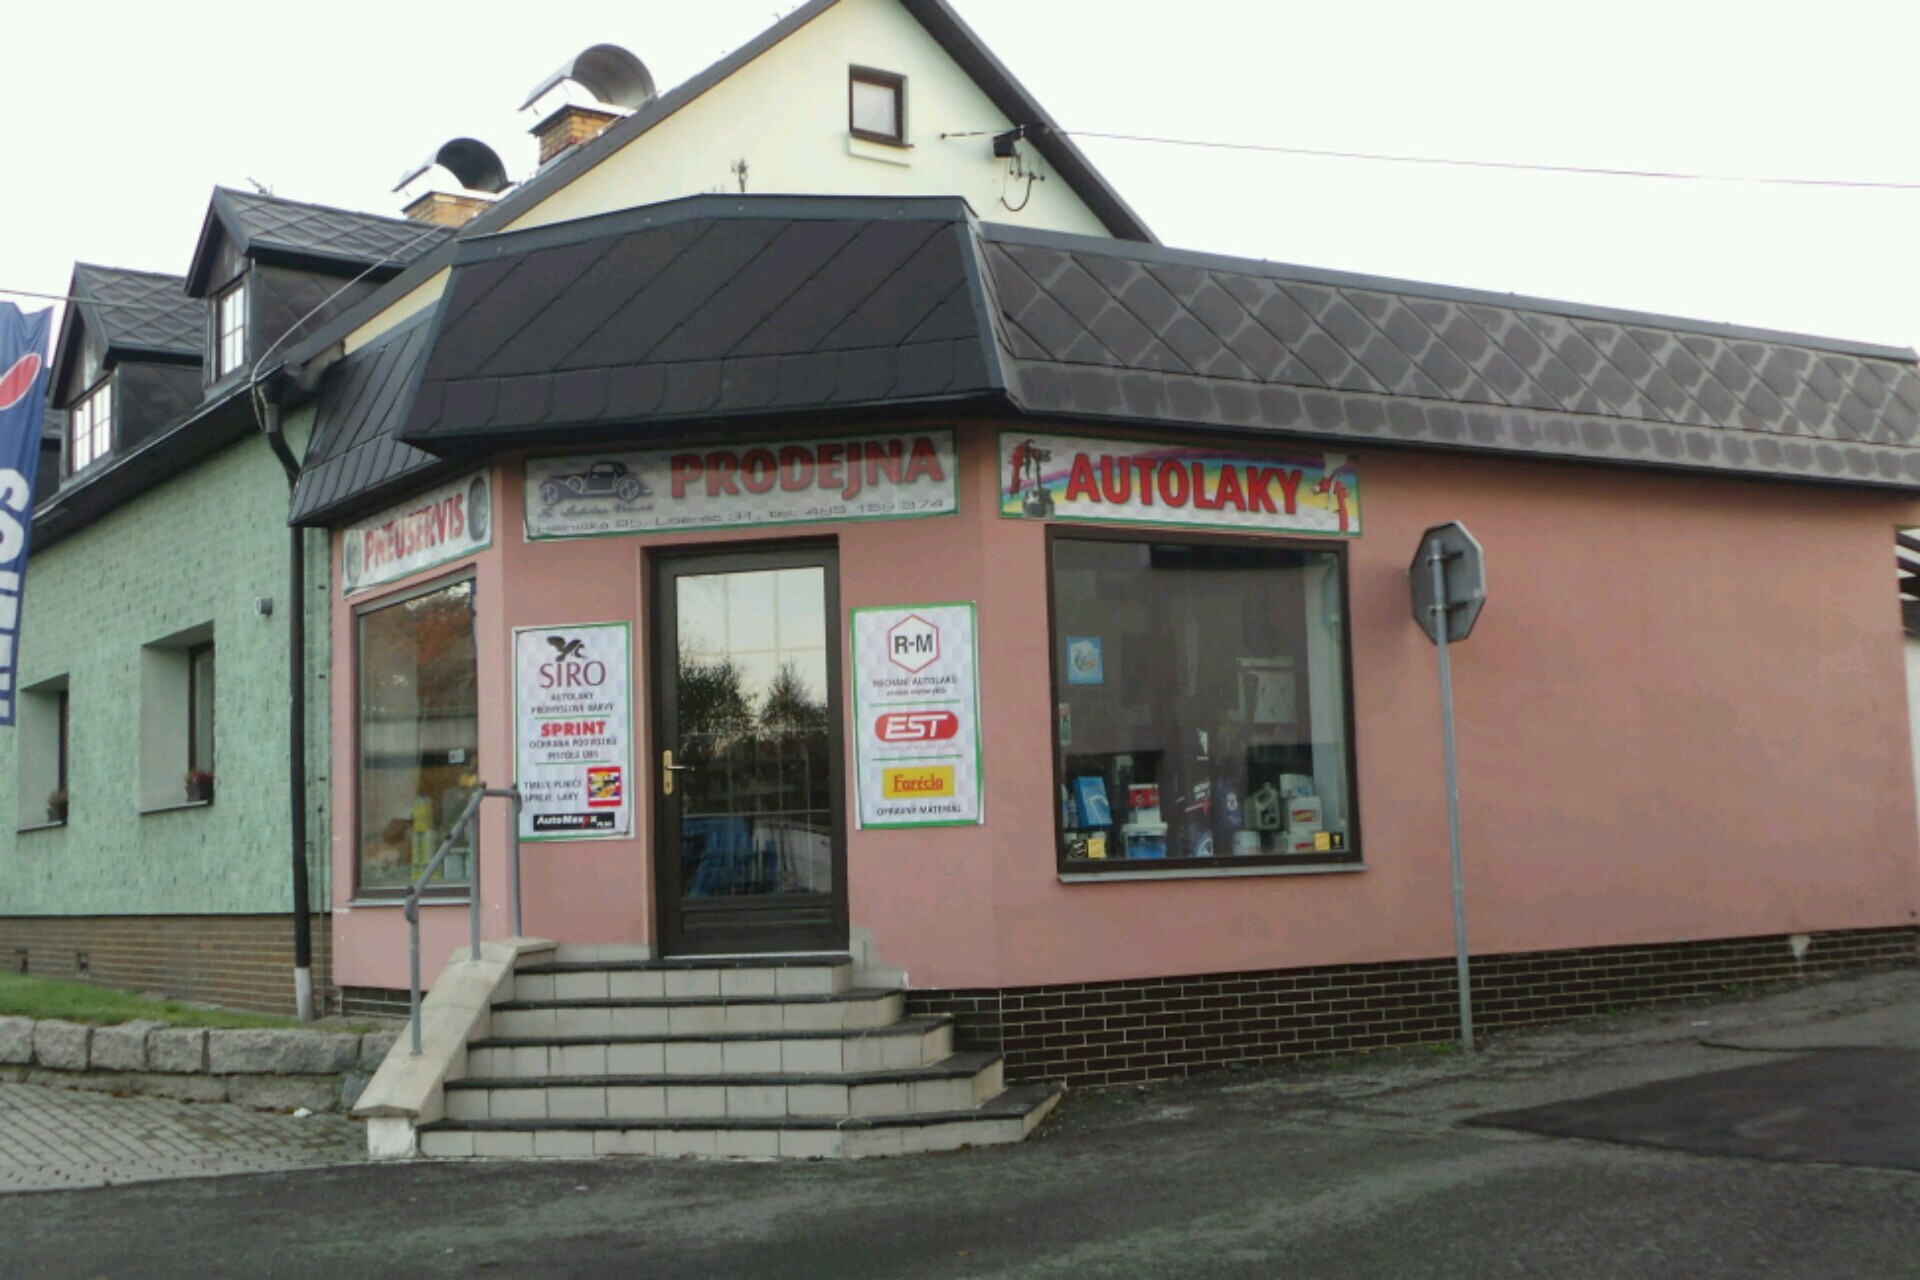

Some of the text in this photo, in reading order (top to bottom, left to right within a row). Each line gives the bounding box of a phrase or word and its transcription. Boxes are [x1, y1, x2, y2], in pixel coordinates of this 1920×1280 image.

[671, 437, 945, 500] PRODEJNA
[1065, 452, 1302, 514] AUTOLAKY
[363, 493, 464, 572] PNEUSERVIS
[894, 633, 933, 655] R-M
[540, 661, 606, 688] SIRO
[550, 691, 594, 702] AUTOLAKY
[540, 720, 607, 737] SPRINT
[884, 713, 949, 740] EST
[529, 739, 570, 749] OCHRANA
